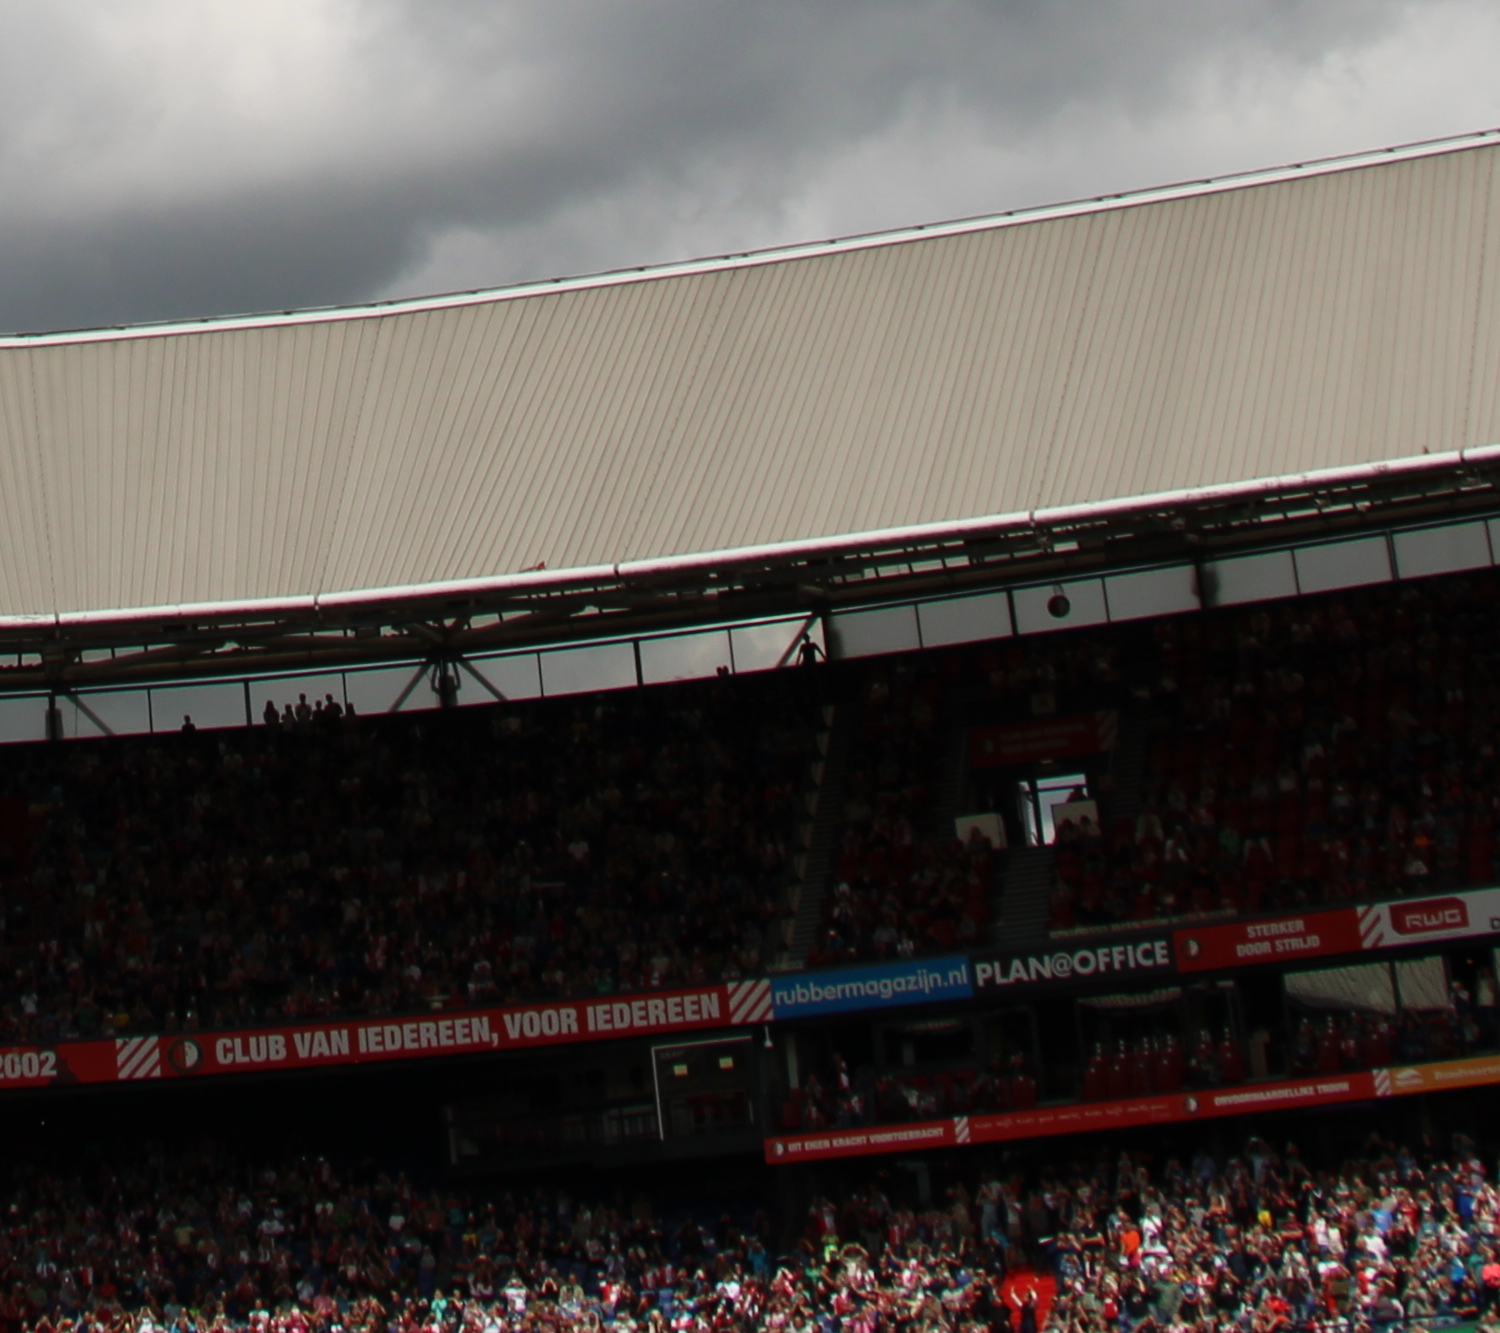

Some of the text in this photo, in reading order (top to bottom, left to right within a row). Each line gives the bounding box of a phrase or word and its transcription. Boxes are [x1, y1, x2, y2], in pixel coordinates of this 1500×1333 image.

[1246, 919, 1305, 939] STERKER
[1404, 909, 1461, 929] RWG
[1236, 935, 1321, 958] DOOR STRIJD
[975, 940, 1169, 987] PLAN@OFFICE
[774, 966, 968, 1006] rubbermagazijn.nl
[216, 992, 721, 1064] CLUB VAN IEDEREEN, VOOR IEDEREEN
